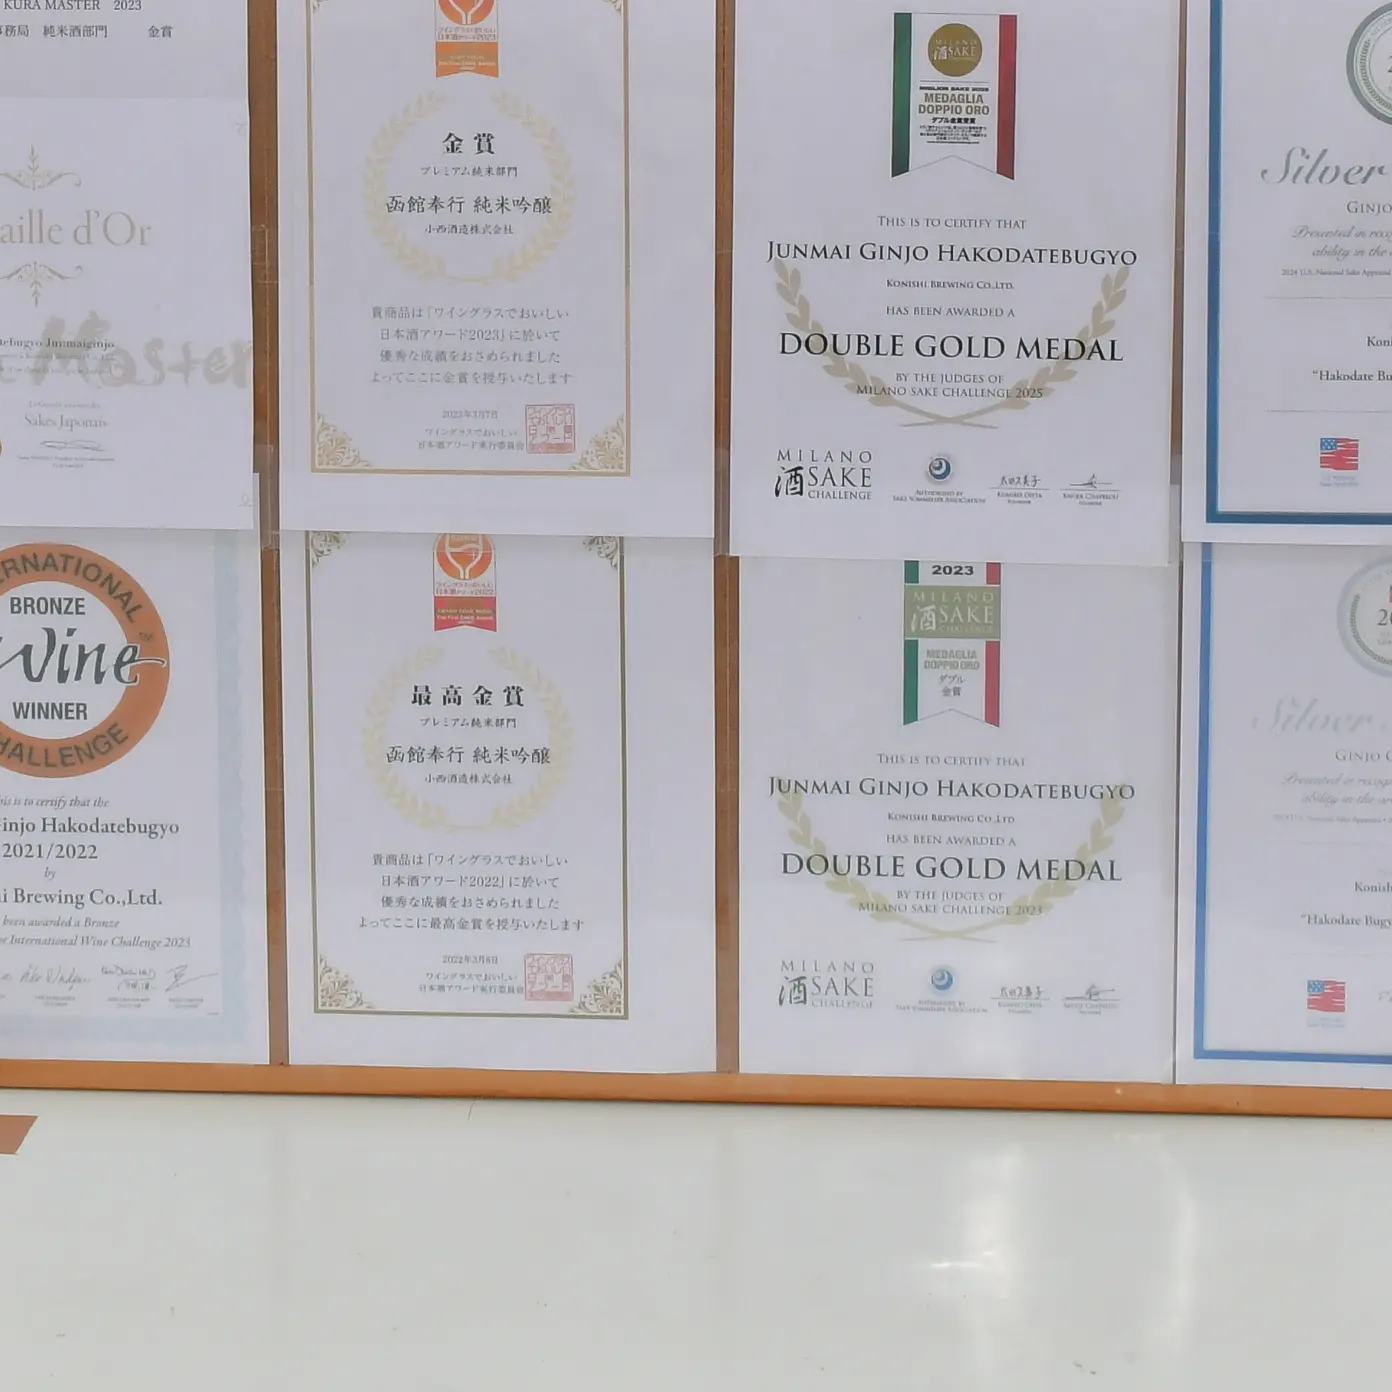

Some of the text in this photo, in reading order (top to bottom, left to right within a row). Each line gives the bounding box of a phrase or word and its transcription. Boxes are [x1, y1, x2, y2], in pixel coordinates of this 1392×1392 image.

[4, 0, 41, 10] KURA
[45, 0, 100, 10] MASTER
[114, 0, 141, 10] 2023
[148, 25, 173, 38] 金賞
[924, 93, 984, 105] MEDAGLIA
[918, 104, 990, 116] DOPPIO ORO
[443, 133, 494, 154] 金賞
[1261, 146, 1387, 186] Silver
[386, 195, 551, 214] 函館奉行 純米吟醸
[1347, 201, 1392, 215] GINJO
[879, 216, 905, 226] THIS
[781, 333, 1123, 361] DOUBLE GOLD MEDAL
[896, 373, 1003, 384] BY THE JUDGES OF
[856, 384, 908, 398] MILANO
[910, 386, 940, 398] SAKE
[776, 450, 872, 465] MILANO
[774, 465, 804, 498] 酒
[807, 467, 873, 489] SAKE
[807, 489, 873, 501] CHALLENGE
[931, 564, 975, 577] 2023
[9, 596, 86, 616] BRONZE
[913, 591, 995, 604] MILANO
[939, 605, 994, 625] SAKE
[412, 685, 523, 707] 最高金賞
[12, 701, 88, 721] WINNER
[386, 746, 464, 764] 函館奉行
[42, 817, 179, 839] Hakodatebugyo
[3, 843, 97, 859] 2021/2022
[44, 867, 56, 881] by
[783, 853, 1121, 881] DOUBLE GOLD MEDAL
[14, 888, 85, 910] Brewing
[780, 960, 876, 976] MILANO
[811, 977, 875, 998] SAKE
